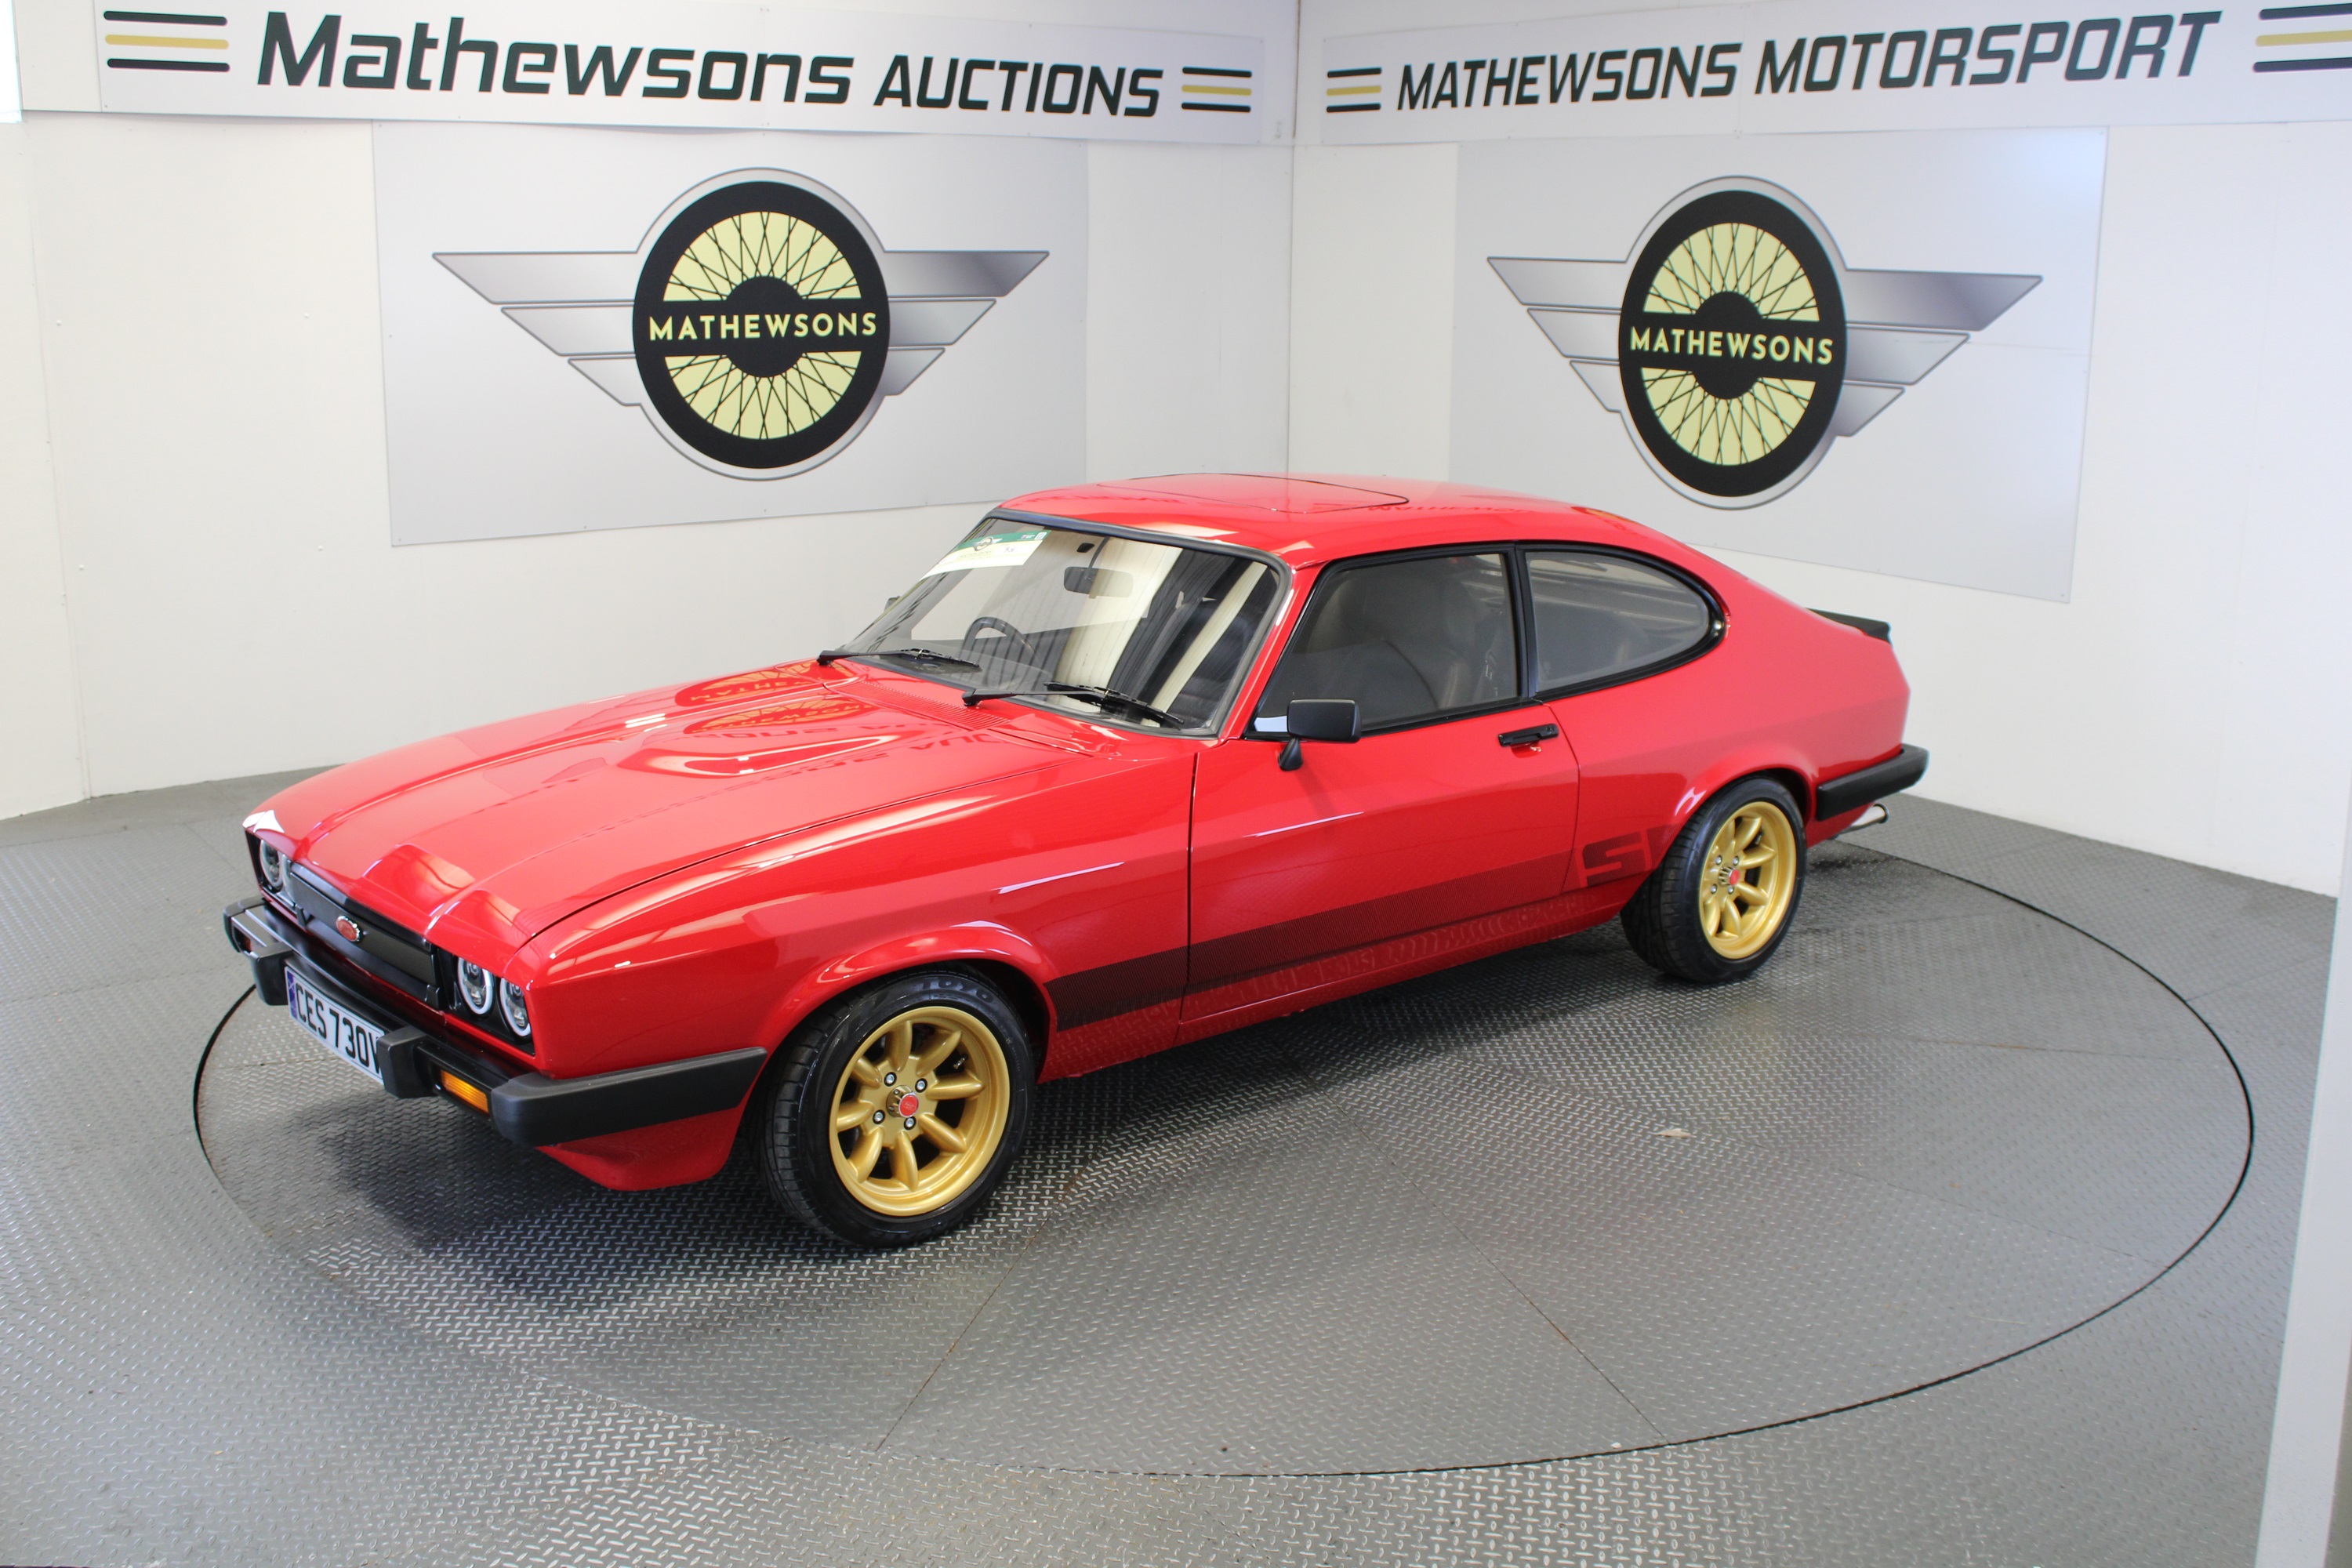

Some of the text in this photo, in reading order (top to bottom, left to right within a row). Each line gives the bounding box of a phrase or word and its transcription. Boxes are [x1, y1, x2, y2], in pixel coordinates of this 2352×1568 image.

[257, 11, 1163, 118] Mathewsons AUCTIONS
[1397, 10, 2223, 111] MATHEWSONS MOTORSPORT
[649, 312, 877, 341] MATHEWSONS
[1630, 326, 1833, 365] MATHEWSONS
[296, 982, 327, 1040] CES
